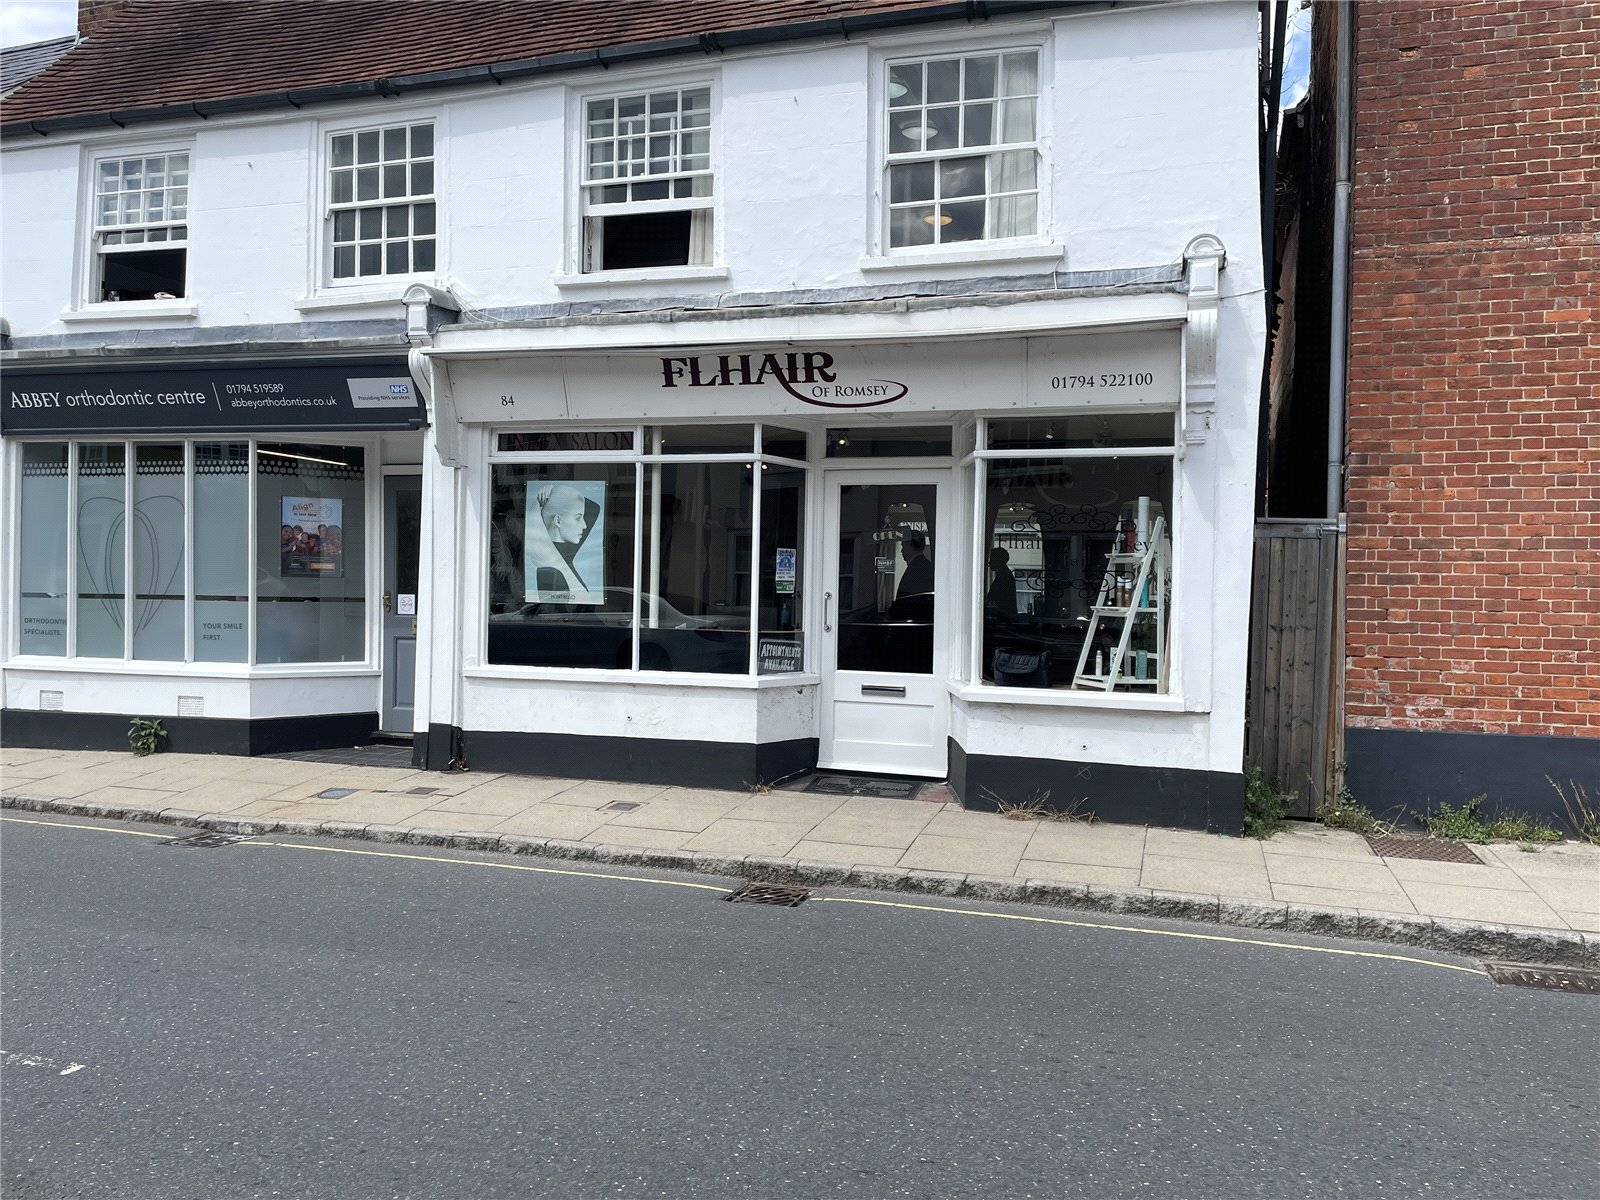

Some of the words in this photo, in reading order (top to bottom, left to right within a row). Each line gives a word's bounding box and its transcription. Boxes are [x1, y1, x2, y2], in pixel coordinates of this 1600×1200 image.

[660, 351, 837, 393] FLHAIR
[1051, 374, 1095, 390] 01794
[1099, 372, 1153, 389] 522100
[226, 384, 251, 395] 01794
[253, 383, 284, 393] 519589
[391, 385, 408, 394] NHS
[811, 387, 831, 399] OF
[834, 384, 890, 398] ROMSEY
[10, 391, 61, 409] ABBEY
[65, 390, 154, 408] orthodontic
[157, 391, 206, 406] centre
[231, 396, 338, 410] abbeyorthodontics.co.uk
[357, 395, 381, 403] Providing
[500, 394, 515, 408] 84
[571, 431, 634, 450] SALON
[292, 502, 314, 512] Align
[203, 622, 221, 630] YOUR
